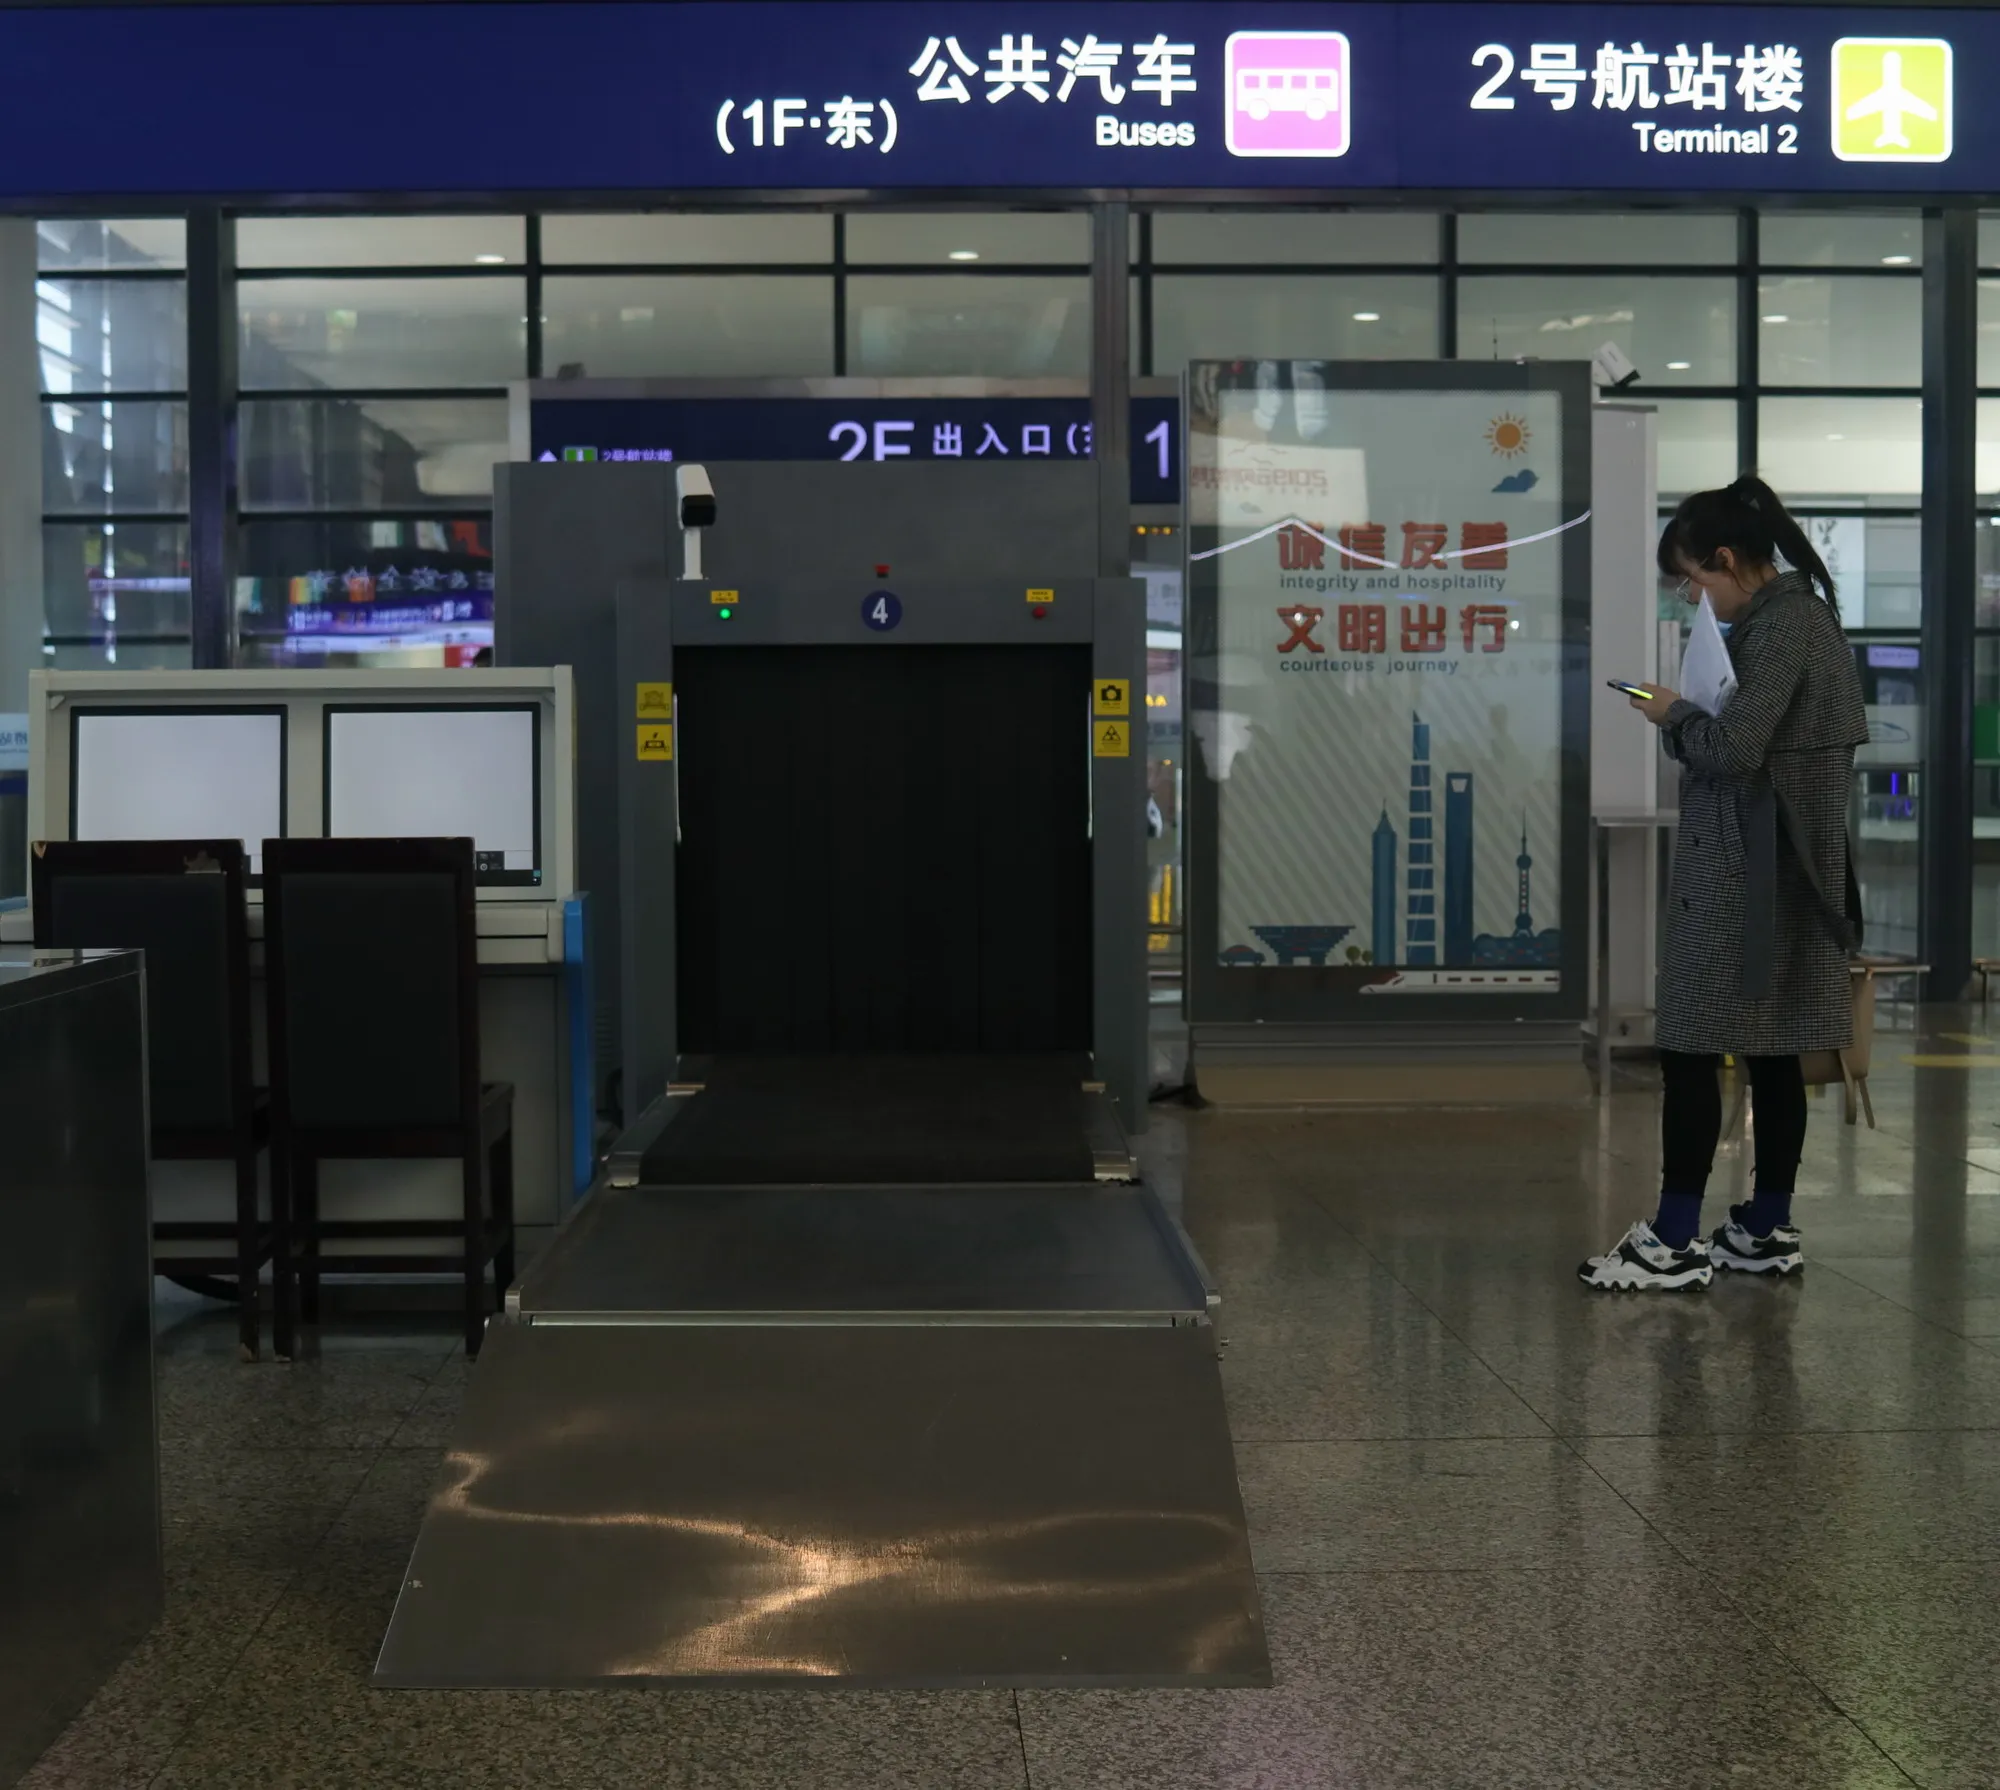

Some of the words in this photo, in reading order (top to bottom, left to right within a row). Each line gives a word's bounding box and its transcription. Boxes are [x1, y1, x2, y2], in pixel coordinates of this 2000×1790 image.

[909, 34, 1198, 107] 公共汽车
[1469, 42, 1804, 112] 2号航站楼
[1095, 114, 1196, 147] Buses
[1632, 121, 1769, 154] Terminal
[1776, 123, 1798, 154] 2
[828, 421, 915, 461] 2F
[1277, 521, 1508, 570] 诚信友善
[1280, 574, 1359, 592] integrity
[1366, 575, 1400, 589] and
[1407, 574, 1506, 592] hospitality
[871, 597, 889, 624] 4
[1276, 603, 1508, 653] 文明出行
[1279, 657, 1375, 672] courteous
[1386, 658, 1459, 675] journey
